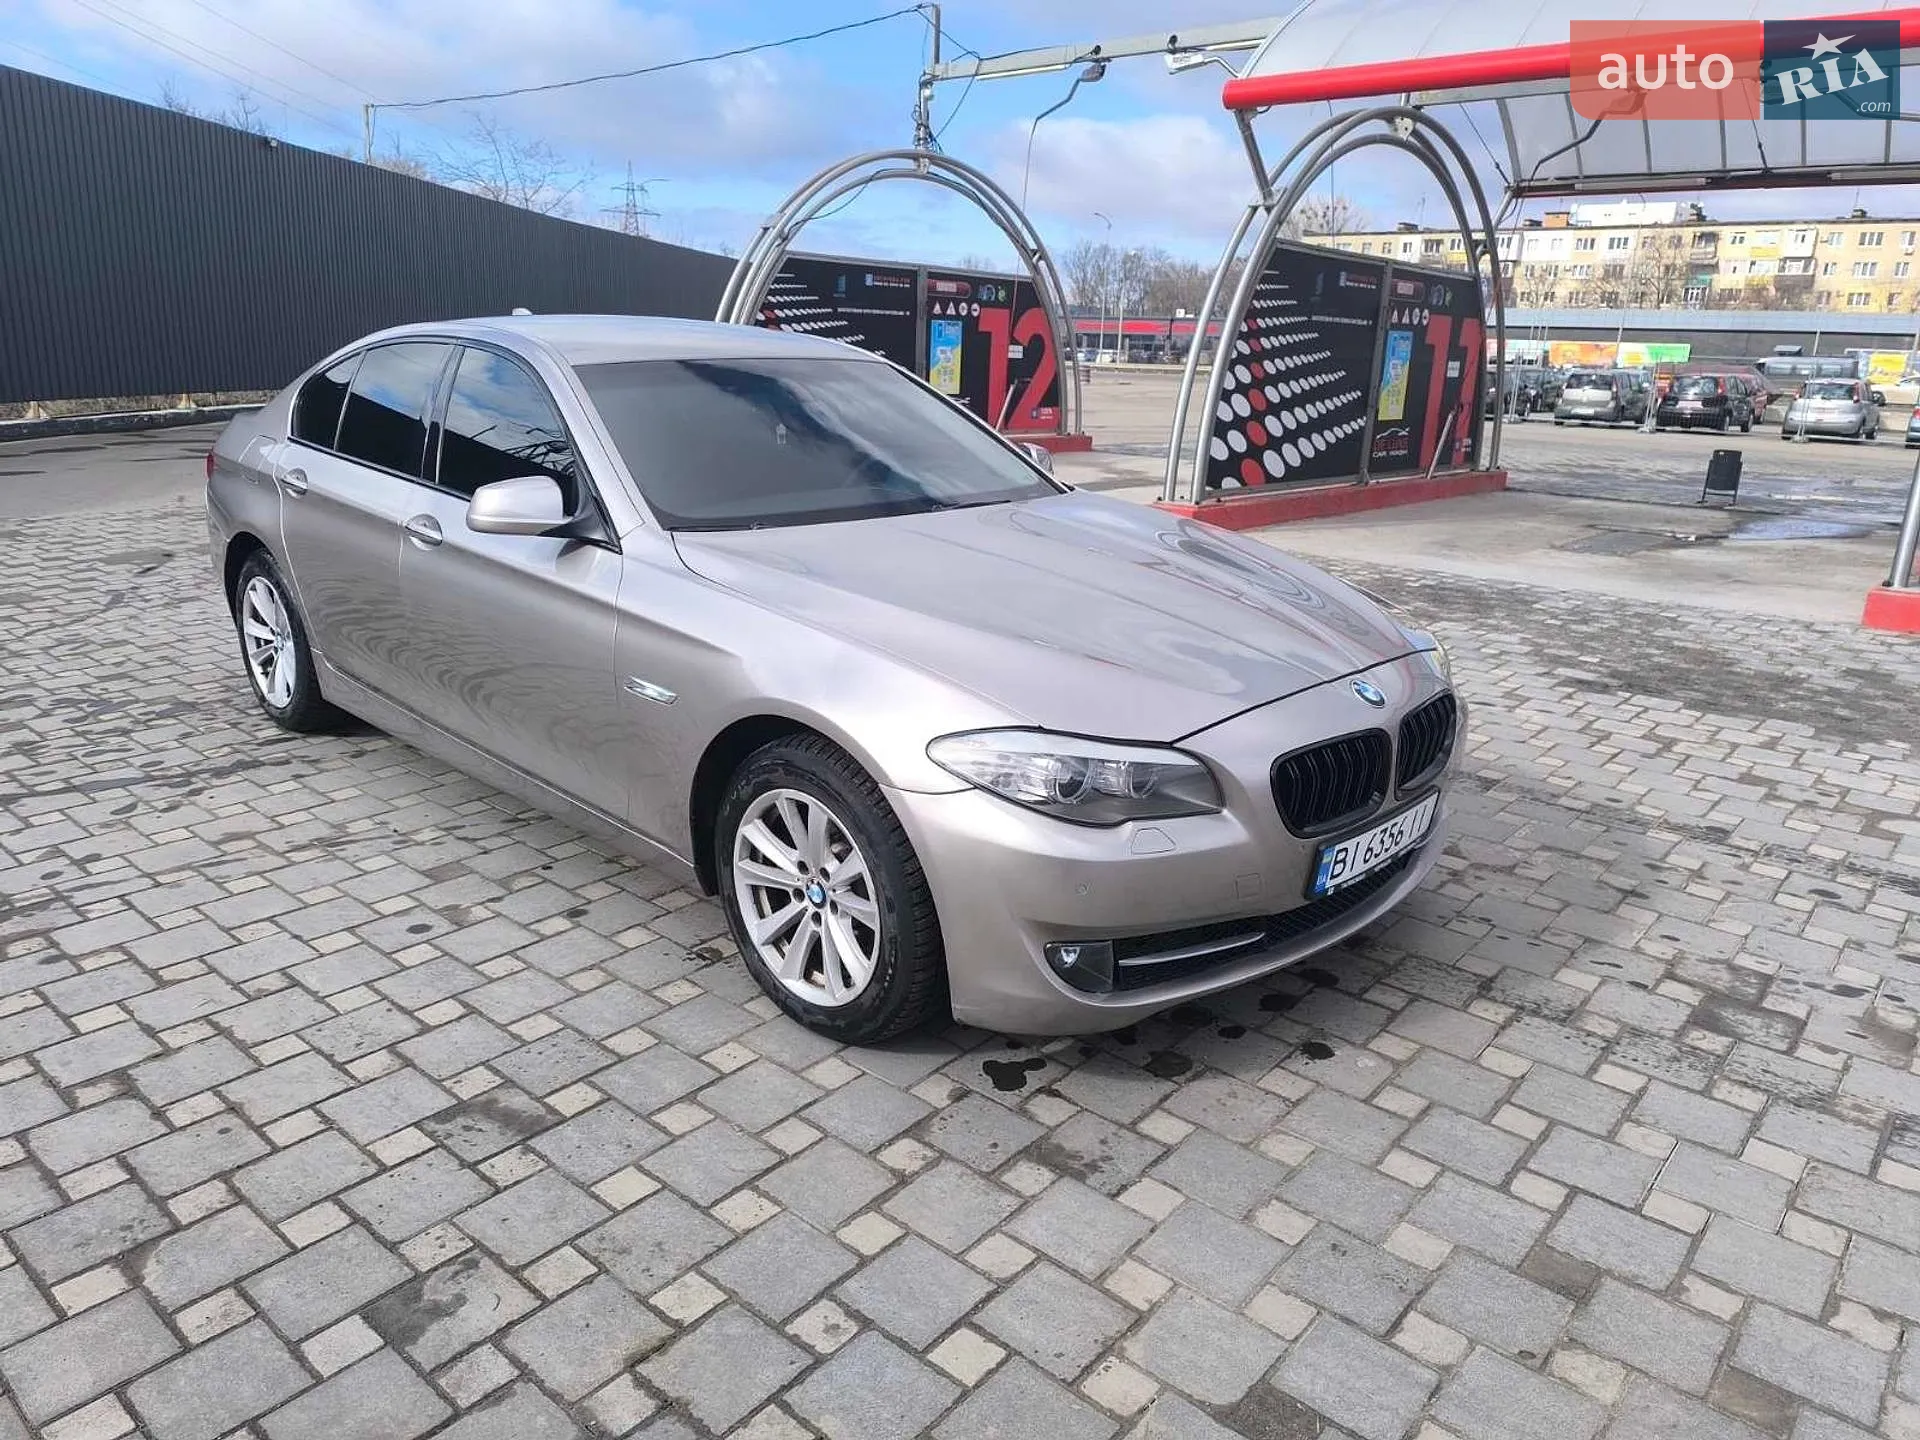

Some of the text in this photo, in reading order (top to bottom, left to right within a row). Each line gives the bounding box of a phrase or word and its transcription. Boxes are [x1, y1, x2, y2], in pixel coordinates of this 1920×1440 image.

[979, 307, 1058, 429] 12
[1420, 315, 1483, 468] 11
[1363, 817, 1407, 864] 6356
